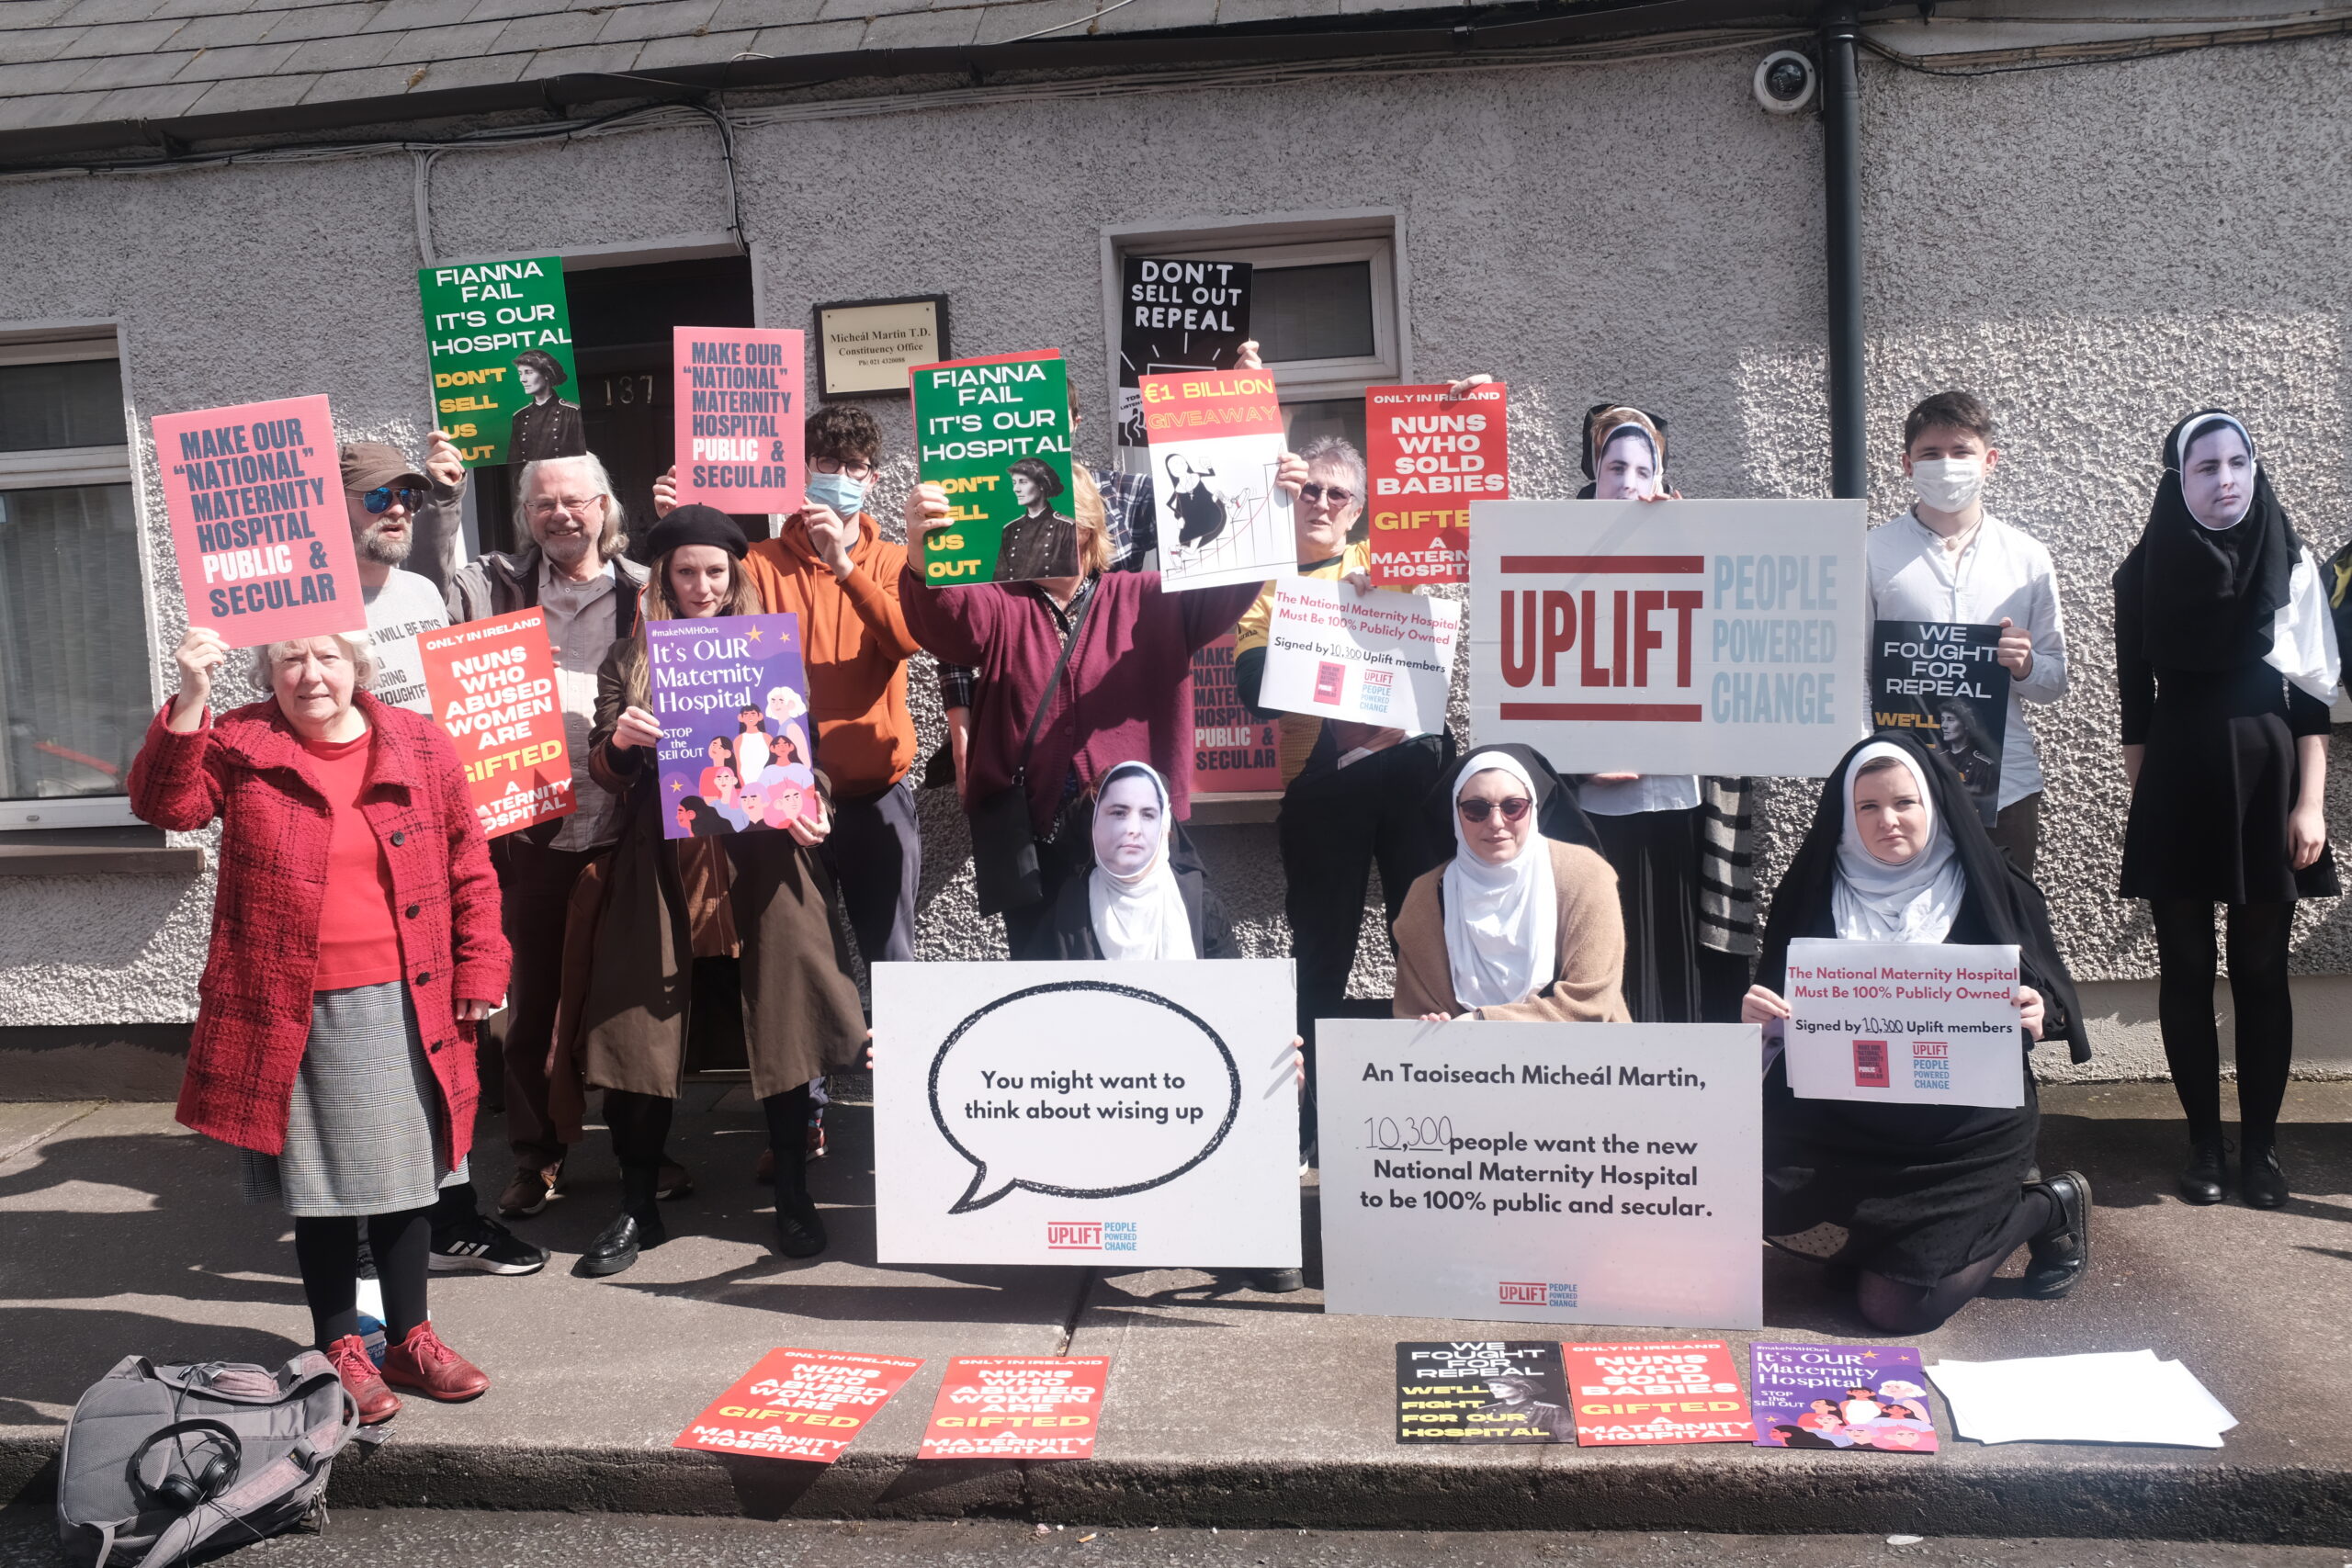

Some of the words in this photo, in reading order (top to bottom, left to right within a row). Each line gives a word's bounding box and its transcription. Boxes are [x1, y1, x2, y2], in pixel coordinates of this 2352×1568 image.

[435, 261, 544, 287] FIANNA
[1141, 261, 1233, 286] DON'T
[461, 283, 524, 303] FAIL
[1132, 285, 1182, 303] SELL
[1193, 288, 1242, 306] OUT
[435, 311, 486, 331] IT'S
[496, 304, 555, 324] OUR
[1136, 306, 1235, 332] REPEAL
[432, 328, 571, 356] HOSPITAL
[831, 332, 869, 344] Micheál
[872, 329, 906, 340] Martin
[909, 327, 931, 337] T.D.
[839, 344, 895, 356] Constituency
[897, 343, 923, 352] Office
[435, 367, 507, 388] DON'T
[605, 376, 652, 405] 137
[1145, 383, 1175, 403] €1
[1182, 378, 1273, 399] BILLION
[439, 395, 498, 413] SELL
[1148, 406, 1276, 429] GIVEAWAY
[1392, 414, 1487, 434] NUNS
[180, 425, 248, 460] MAKE
[252, 418, 304, 450] OUR
[1397, 435, 1480, 454] WHO
[1395, 455, 1485, 474] SOLD
[1377, 474, 1505, 495] BABIES
[191, 477, 323, 522] MATERNITY
[197, 511, 315, 552] HOSPITAL
[202, 545, 293, 583] PUBLIC
[309, 541, 329, 570] &
[1713, 554, 1837, 611] PEOPLE
[209, 573, 336, 617] SECULAR
[1277, 592, 1297, 604] The
[1300, 595, 1349, 613] National
[1351, 604, 1408, 625] Maternity
[1411, 614, 1458, 630] Hospital
[375, 626, 405, 643] WILL
[404, 622, 420, 637] BE
[426, 634, 467, 650] ONLY
[468, 631, 481, 642] IN
[483, 617, 541, 638] IRELAND
[651, 626, 718, 637] #makeNMHOurs
[1279, 609, 1307, 622] Must
[1311, 613, 1325, 624] Be
[1329, 616, 1357, 631] 100%
[1359, 622, 1405, 640] Publicly
[1408, 629, 1450, 645] Owned
[1919, 625, 1967, 642] WE
[1500, 591, 1703, 688] UPLIFT
[1713, 618, 1837, 663] POWERED
[653, 643, 687, 664] It's
[694, 637, 751, 660] OUR
[1274, 637, 1312, 650] Signed
[1316, 640, 1329, 656] by
[1363, 651, 1393, 665] Uplift
[1396, 659, 1446, 673] members
[1884, 642, 1998, 661] FOUGHT
[451, 646, 527, 678] NUNS
[1912, 661, 1967, 679] FOR
[460, 666, 526, 694] WHO
[656, 663, 764, 689] Maternity
[1364, 671, 1394, 684] UPLIFT
[1362, 684, 1391, 696] PEOPLE
[1712, 671, 1836, 724] CHANGE
[1886, 679, 1992, 699] REPEAL
[446, 678, 552, 720] ABUSED
[659, 686, 751, 714] Hospital
[1360, 702, 1388, 714] CHANGE
[446, 696, 552, 738] WOMEN
[1875, 712, 1940, 729] WE'LL
[478, 721, 533, 750] ARE
[663, 728, 693, 739] STOP
[1195, 727, 1250, 748] PUBLIC
[1262, 728, 1274, 745] &
[671, 739, 687, 749] the
[683, 748, 704, 759] OUT
[1195, 749, 1276, 771] SECULAR
[1788, 966, 1813, 979] The
[1816, 967, 1877, 980] National
[1882, 968, 1953, 983] Maternity
[1956, 967, 2017, 983] Hospital
[1795, 987, 1828, 998] Must
[1832, 987, 1849, 998] Be
[1853, 987, 1892, 998] 100%
[1895, 987, 1951, 1002] Publicly
[1956, 987, 2010, 999] Owned
[1795, 1020, 1841, 1033] Signed
[1845, 1020, 1860, 1034] by
[1906, 1021, 1943, 1035] Uplift
[1948, 1022, 2013, 1033] members
[1913, 1045, 1948, 1055] UPLIFT
[1914, 1059, 1950, 1069] PEOPLE
[980, 1070, 1023, 1089] You
[1030, 1070, 1093, 1094] might
[1099, 1073, 1157, 1089] want
[1162, 1073, 1185, 1089] to
[1362, 1063, 1394, 1082] An
[1400, 1063, 1515, 1084] Taoiseach
[1522, 1065, 1611, 1086] Micheál
[1618, 1066, 1706, 1089] Martin,
[1914, 1070, 1950, 1079] POWERED
[1915, 1080, 1950, 1089] CHANGE
[965, 1100, 1020, 1119] think
[1025, 1100, 1091, 1119] about
[1097, 1102, 1169, 1123] wising
[1176, 1105, 1204, 1123] up
[1450, 1132, 1528, 1156] people
[1533, 1135, 1595, 1153] want
[1602, 1134, 1640, 1154] the
[1646, 1140, 1698, 1155] new
[1374, 1159, 1472, 1180] National
[1479, 1162, 1594, 1189] Maternity
[1600, 1165, 1698, 1190] Hospital
[1360, 1192, 1383, 1208] to
[1389, 1190, 1417, 1209] be
[1423, 1190, 1487, 1211] 100%
[1493, 1192, 1562, 1215] public
[1568, 1195, 1613, 1215] and
[1621, 1196, 1713, 1217] secular.
[1048, 1226, 1102, 1245] UPLIFT
[1104, 1223, 1136, 1231] PEOPLE
[1104, 1242, 1136, 1251] CHANGE
[1499, 1286, 1547, 1301] UPLIFT
[1412, 1349, 1544, 1360] FOUGHT
[1451, 1342, 1505, 1351] WE
[1448, 1359, 1510, 1368] FOR
[1757, 1352, 1792, 1363] It's
[1801, 1354, 1864, 1365] OUR
[978, 1370, 1073, 1378] NUNS
[1417, 1367, 1544, 1378] REPEAL
[1758, 1363, 1878, 1380] Maternity
[1758, 1374, 1862, 1388] Hospital
[952, 1386, 1095, 1394] ABUSED
[1402, 1385, 1489, 1394] WE'LL
[949, 1395, 1090, 1404] WOMEN
[1402, 1401, 1486, 1409] FIGHT
[935, 1416, 1091, 1427] GIFTED
[1402, 1414, 1458, 1422] FOR
[1466, 1414, 1527, 1422] OUR
[1403, 1427, 1549, 1437] HOSPITAL
[922, 1438, 1094, 1447] MATERNITY
[935, 1446, 1078, 1454] HOSPITAL
